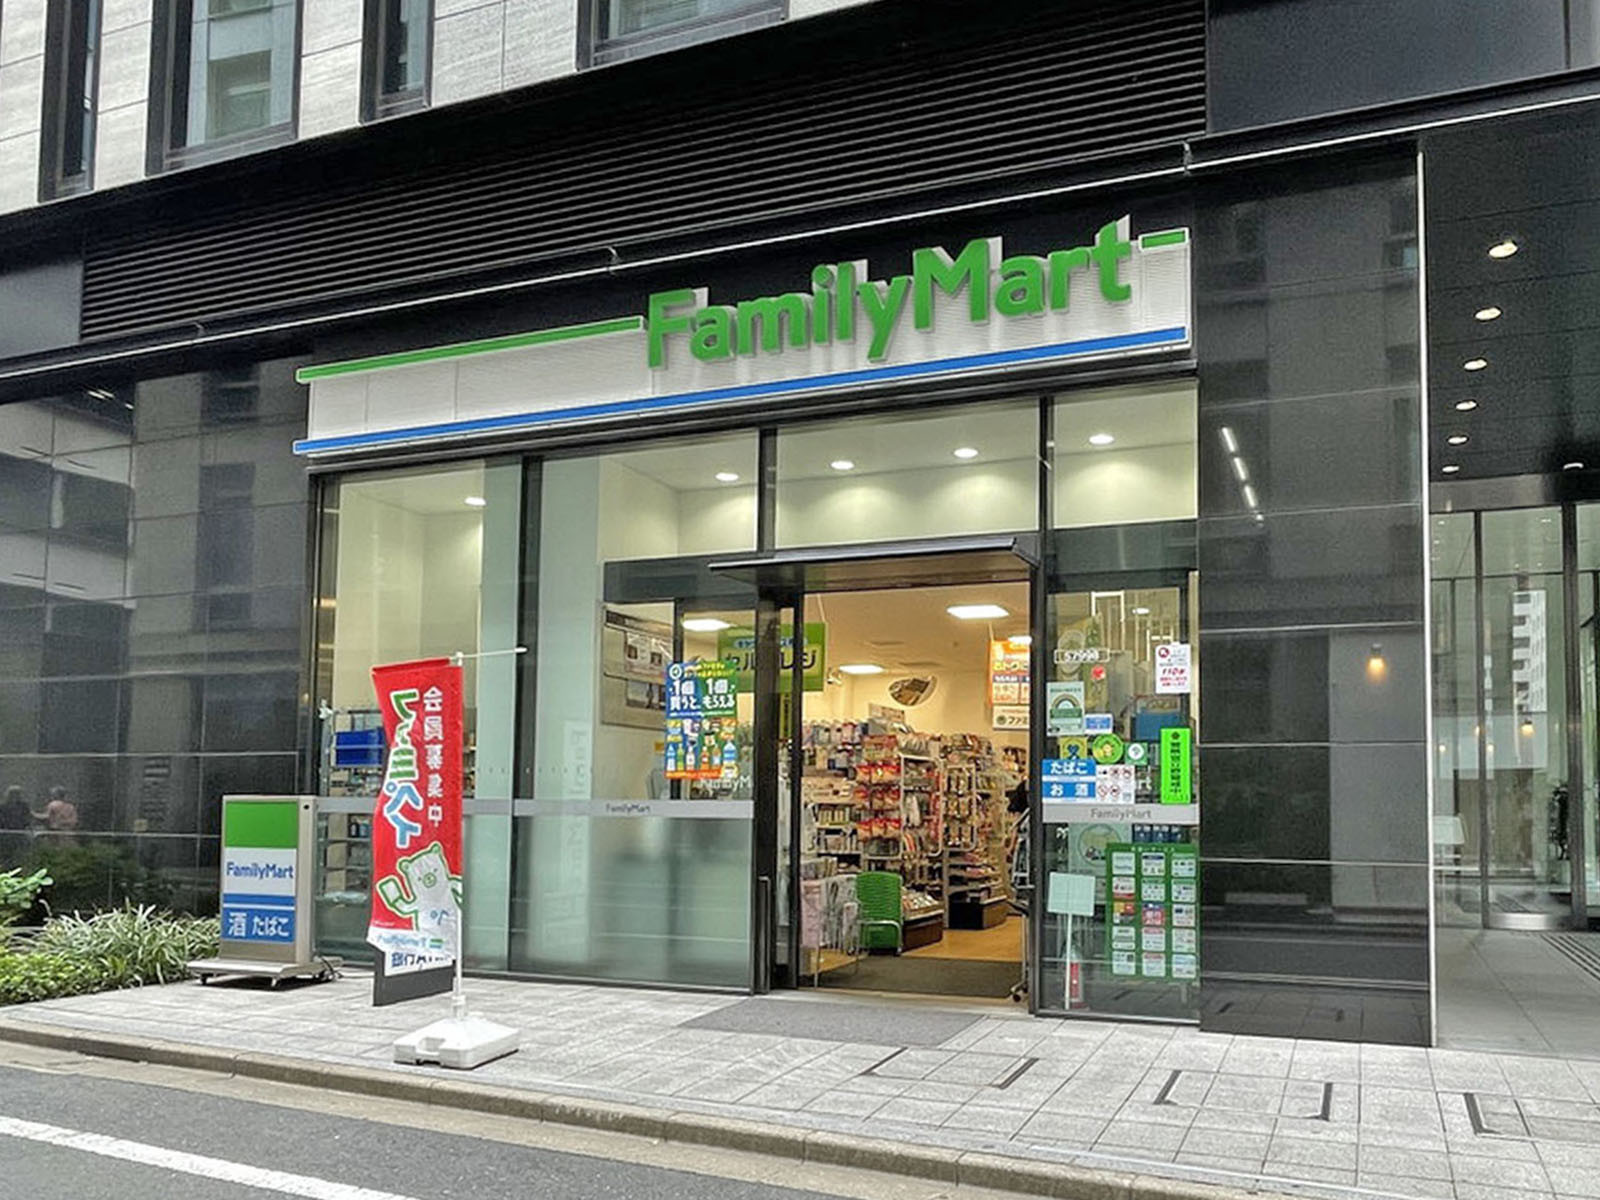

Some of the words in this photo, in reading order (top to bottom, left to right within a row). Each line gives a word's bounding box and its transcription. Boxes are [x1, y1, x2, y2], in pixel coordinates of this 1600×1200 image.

[648, 217, 1132, 368] FamilyMart
[1050, 761, 1088, 775] たばこ
[1090, 808, 1151, 821] FamilyMart
[226, 861, 294, 880] FamilyMart
[228, 911, 247, 937] 酒
[252, 915, 290, 937] たばこ
